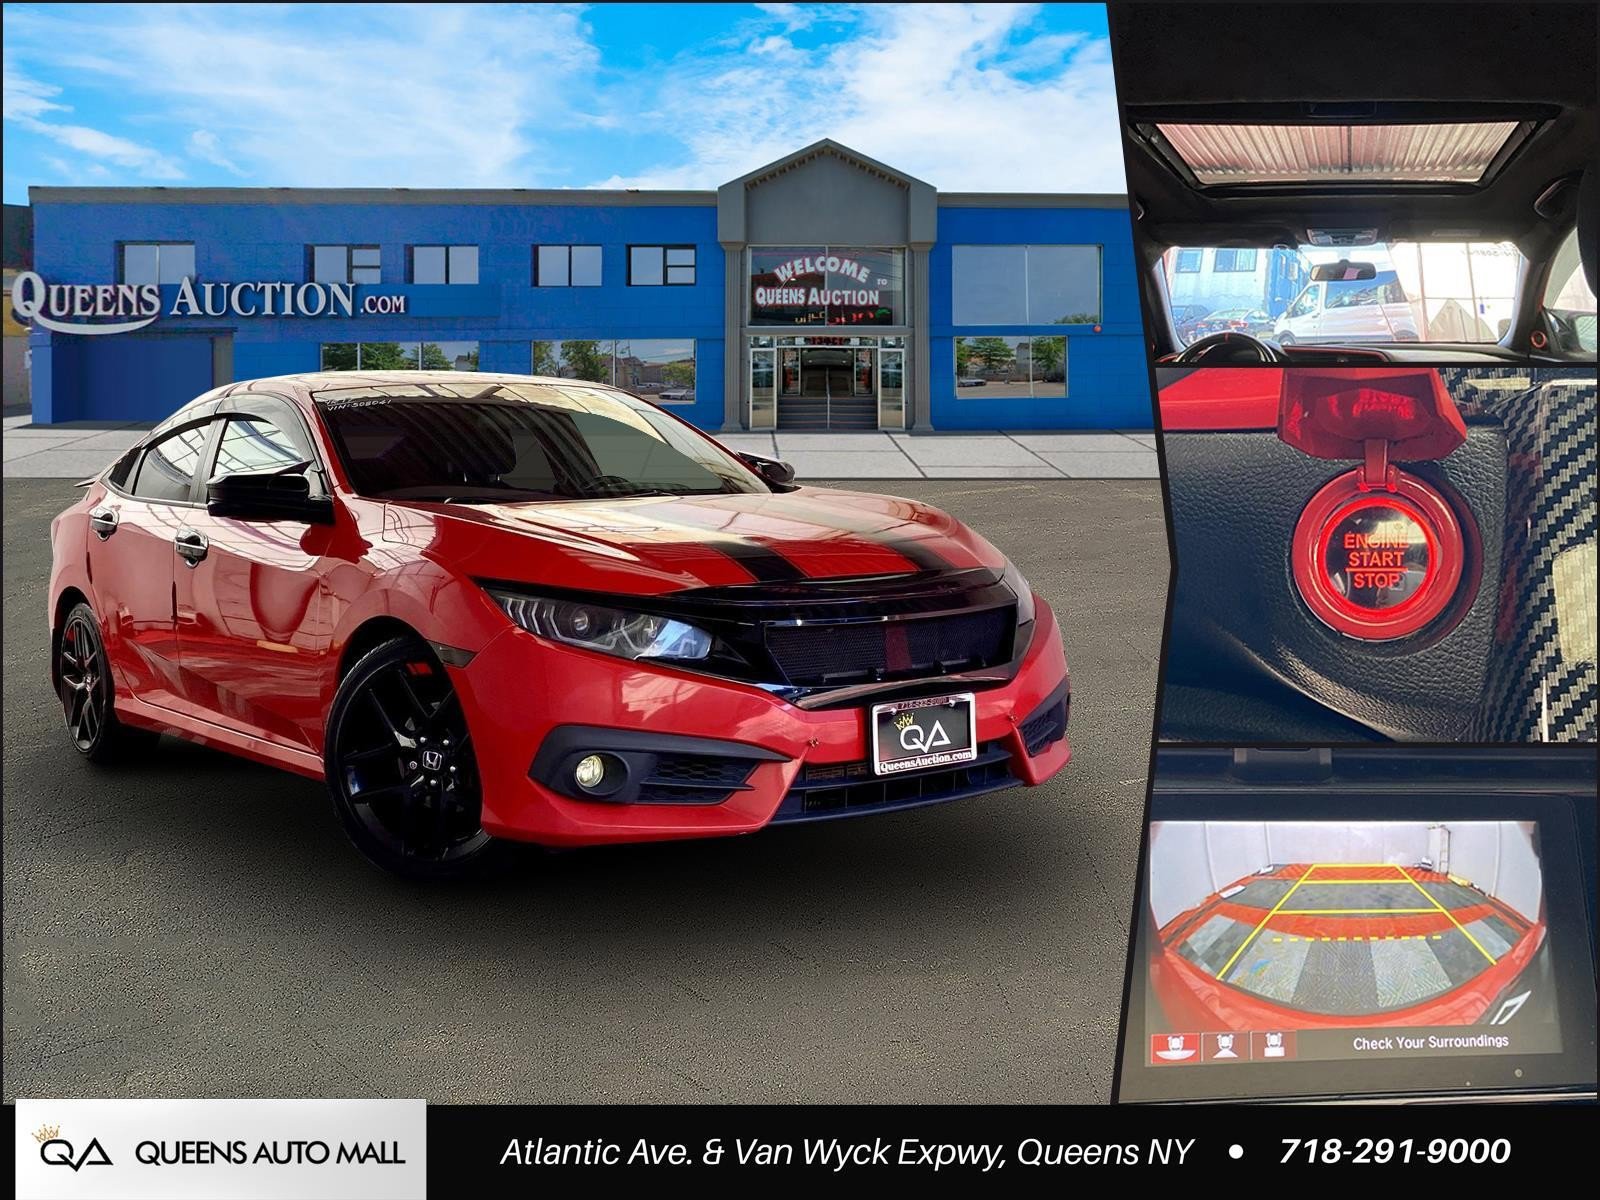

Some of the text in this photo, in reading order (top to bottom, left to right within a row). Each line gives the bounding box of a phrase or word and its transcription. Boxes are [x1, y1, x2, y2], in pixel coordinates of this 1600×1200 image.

[774, 256, 871, 283] WELCOME
[12, 272, 161, 335] QUEENS
[170, 276, 356, 317] AUCTION
[755, 287, 880, 308] QUEENS AUCTION
[1344, 533, 1409, 549] ENGINE
[1349, 551, 1404, 567] START
[1354, 573, 1400, 588] STOP
[880, 751, 972, 773] QueensAuction.com
[1353, 1034, 1509, 1050] Check Your Surroundings
